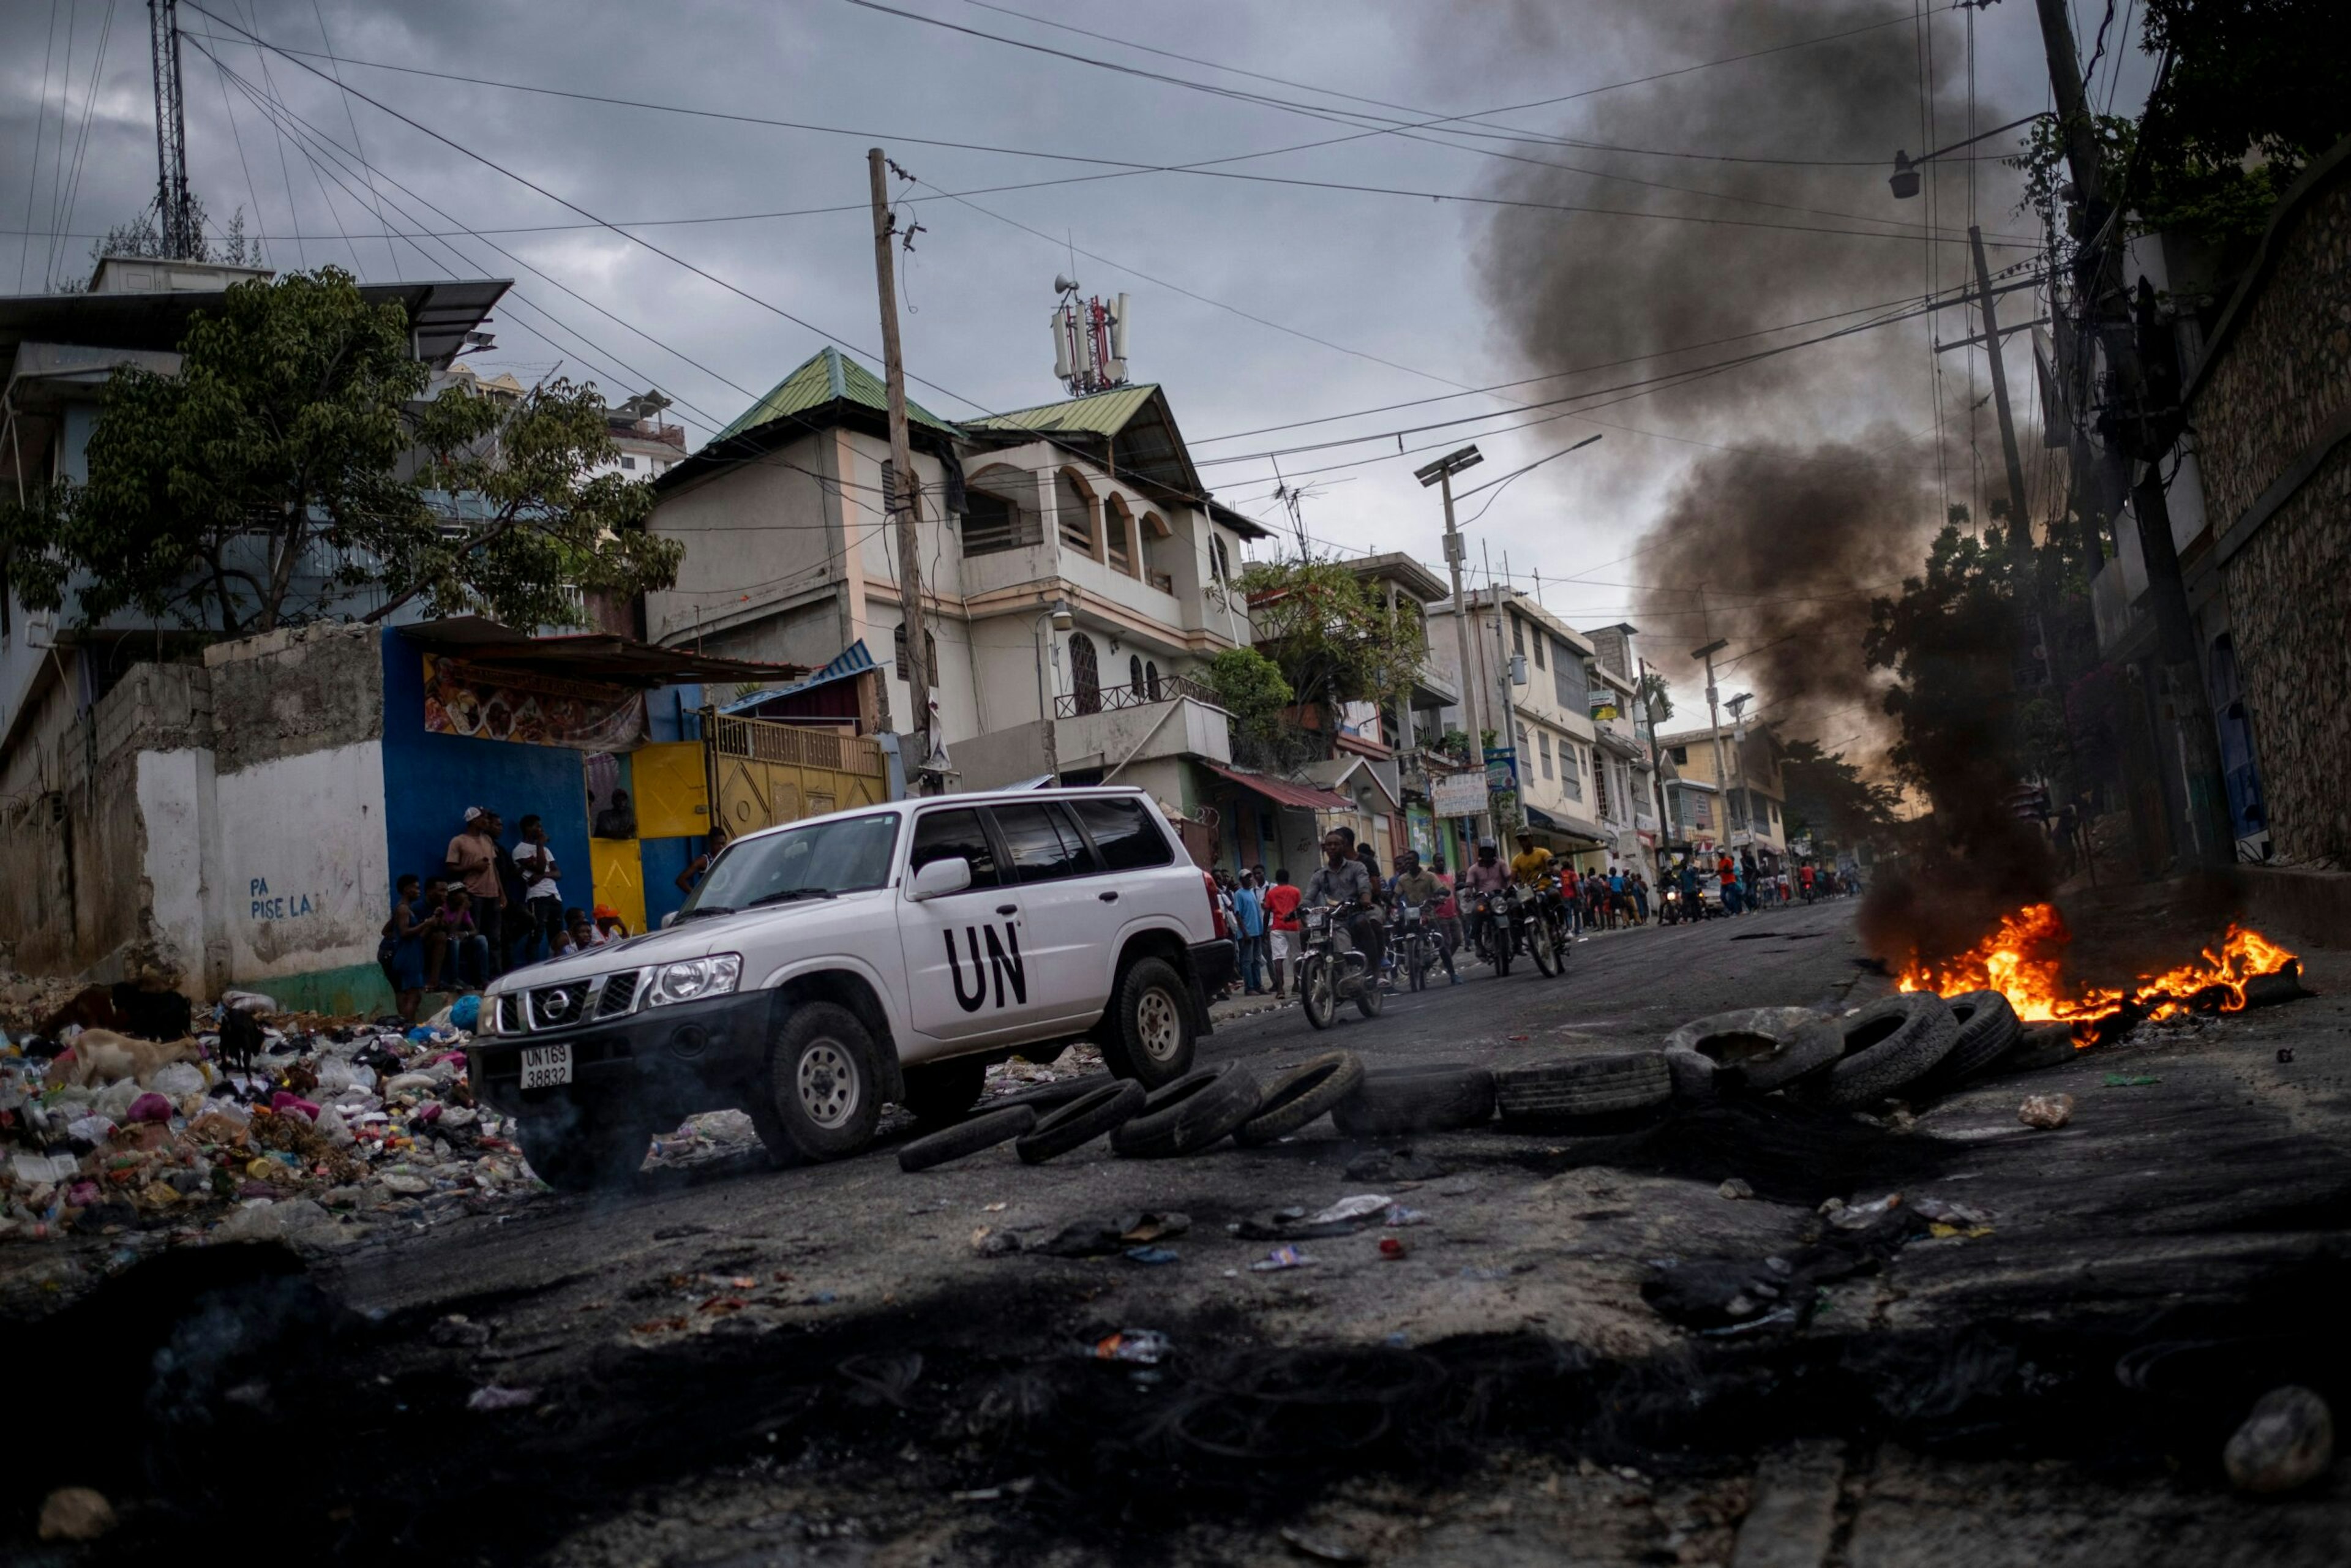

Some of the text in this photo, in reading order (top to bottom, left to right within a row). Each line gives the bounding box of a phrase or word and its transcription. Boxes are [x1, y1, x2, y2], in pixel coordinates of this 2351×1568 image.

[251, 877, 268, 897] PA
[252, 894, 313, 919] PISE LA
[943, 921, 1027, 1012] UN
[528, 1067, 566, 1087] 38832
